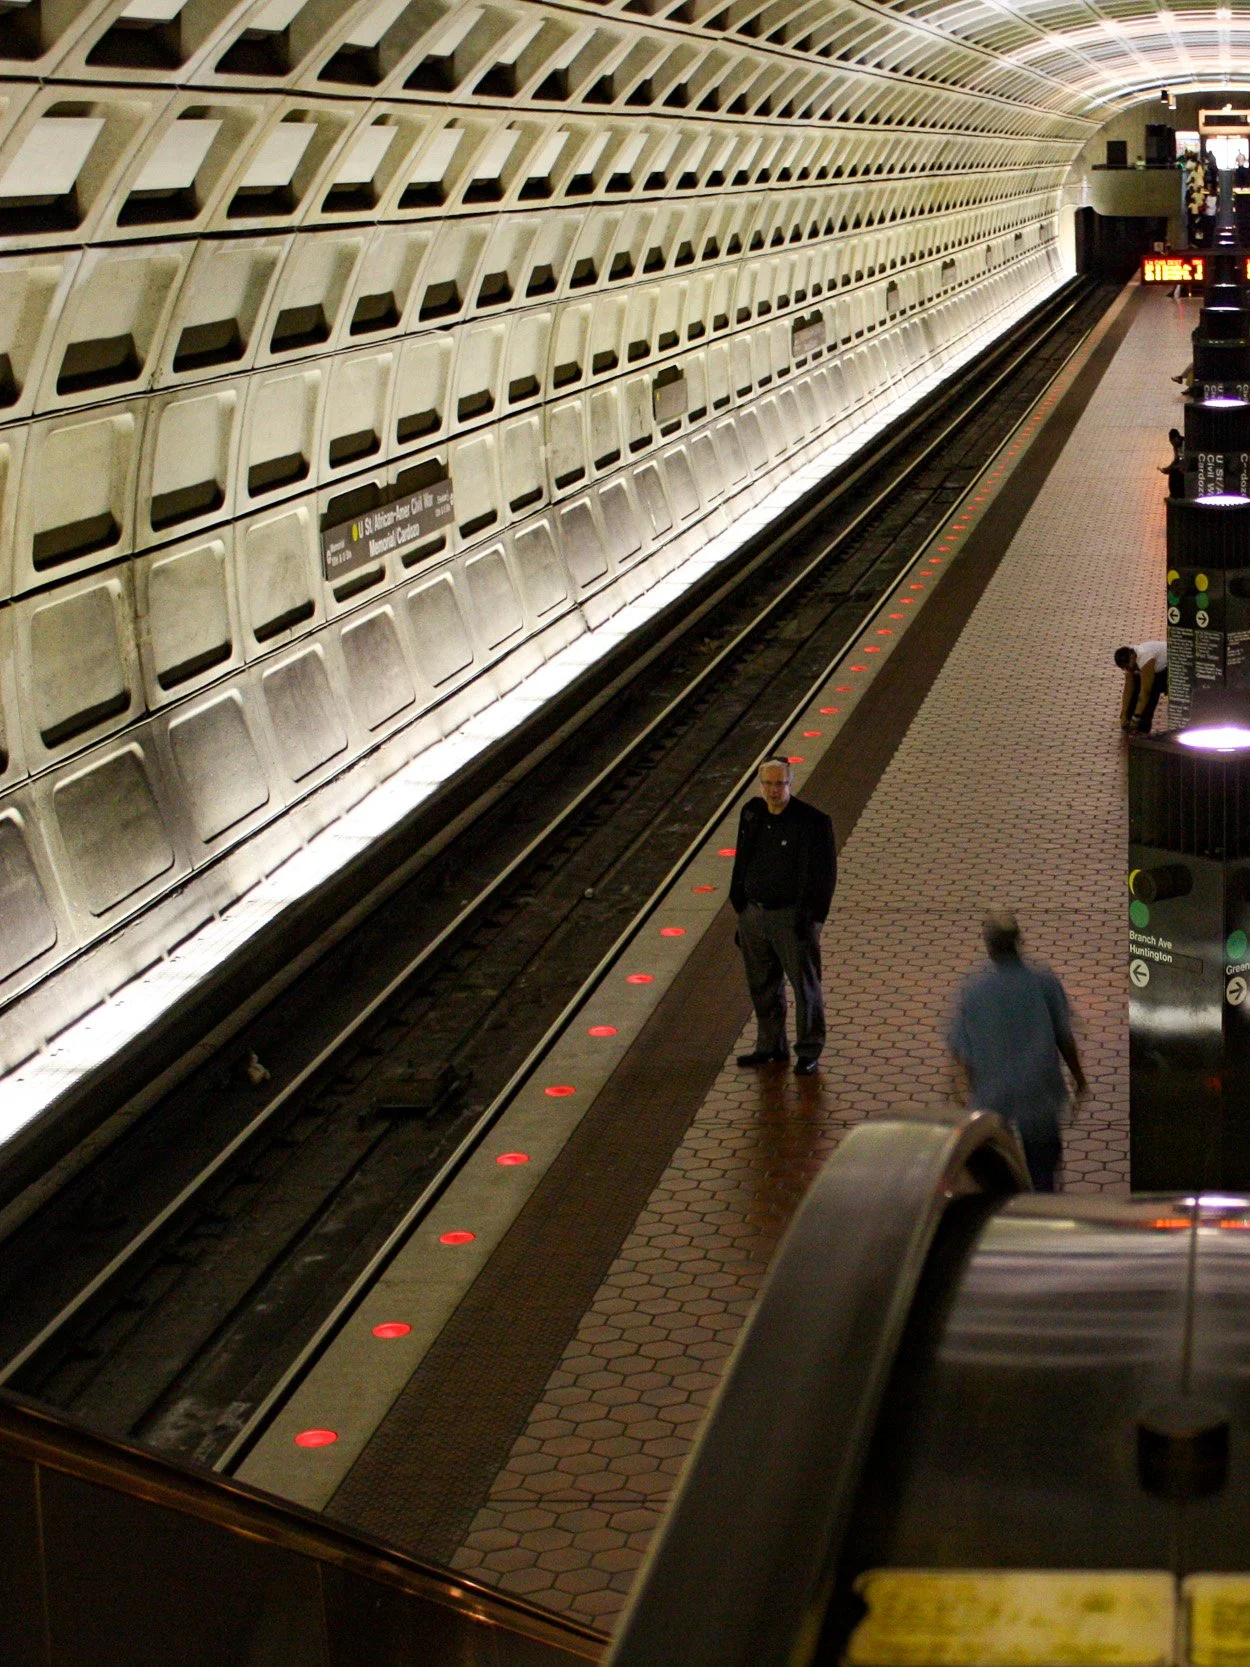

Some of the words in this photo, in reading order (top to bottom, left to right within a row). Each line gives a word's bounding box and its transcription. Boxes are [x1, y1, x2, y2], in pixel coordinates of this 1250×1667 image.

[1207, 454, 1215, 478] Civil
[358, 520, 364, 539] U
[410, 495, 424, 515] Civil
[423, 492, 434, 509] War
[1129, 930, 1157, 945] Branch
[1157, 937, 1173, 949] Ave
[1129, 943, 1173, 963] Huntington
